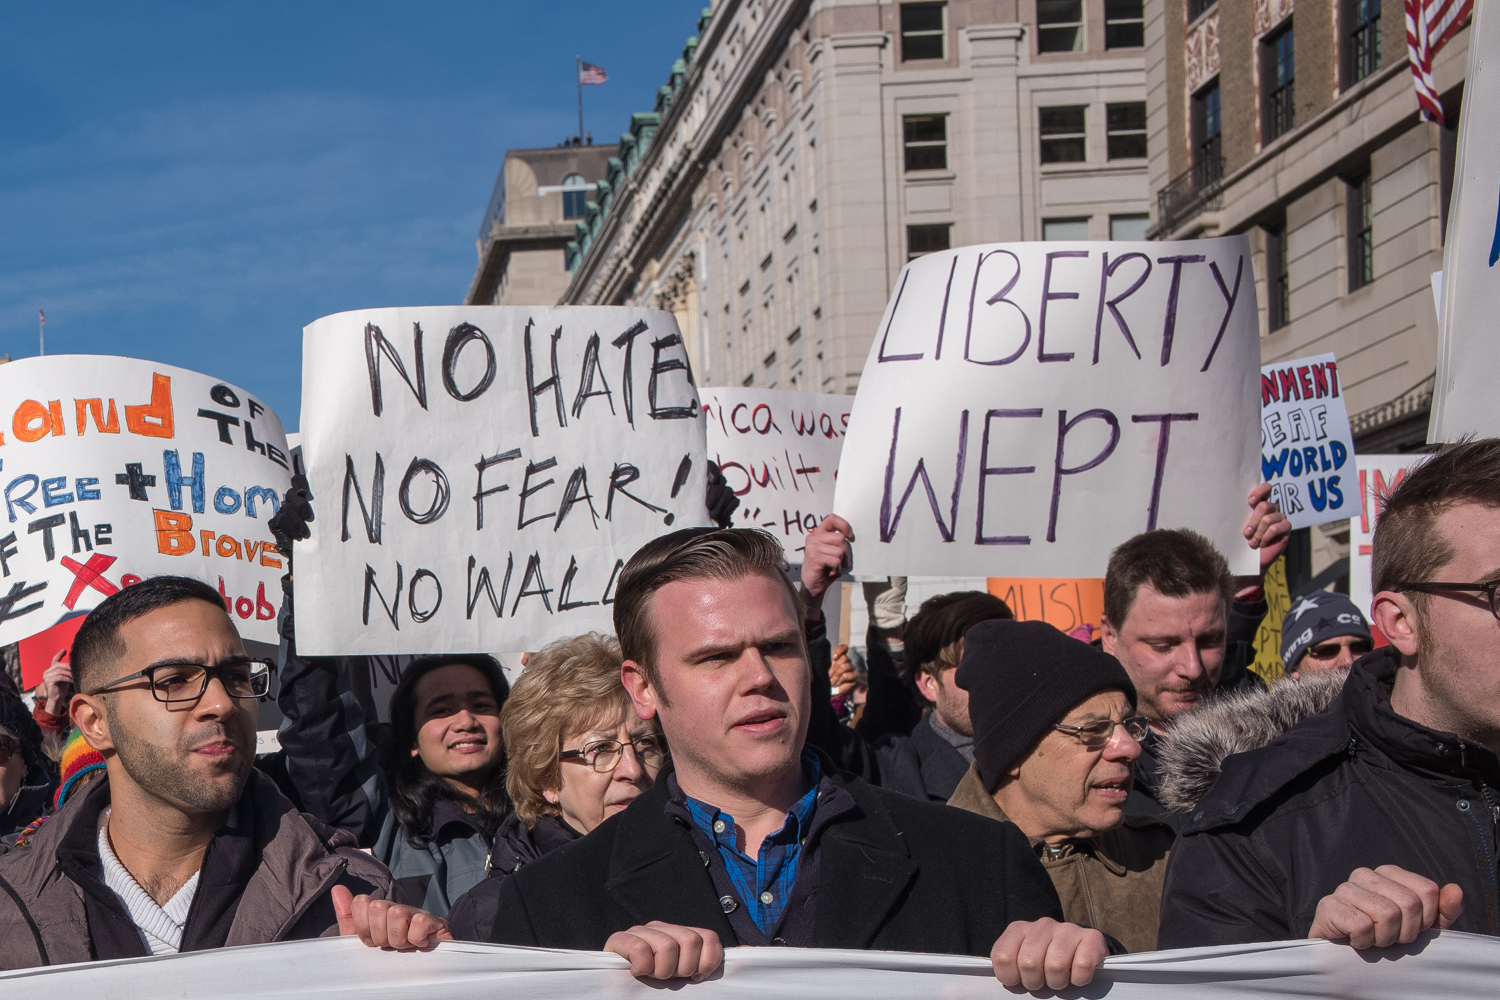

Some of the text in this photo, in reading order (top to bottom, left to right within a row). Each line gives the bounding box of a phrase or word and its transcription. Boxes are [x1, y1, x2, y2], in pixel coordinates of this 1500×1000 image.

[877, 249, 1243, 373] LIBERTY
[364, 321, 497, 417] NO
[163, 449, 287, 519] Hom
[341, 447, 693, 545] NO FEAR!
[715, 449, 821, 496] built
[879, 407, 1199, 545] WEPT
[1261, 440, 1347, 482] WORLD
[1307, 475, 1344, 512] US
[362, 560, 442, 631] NO
